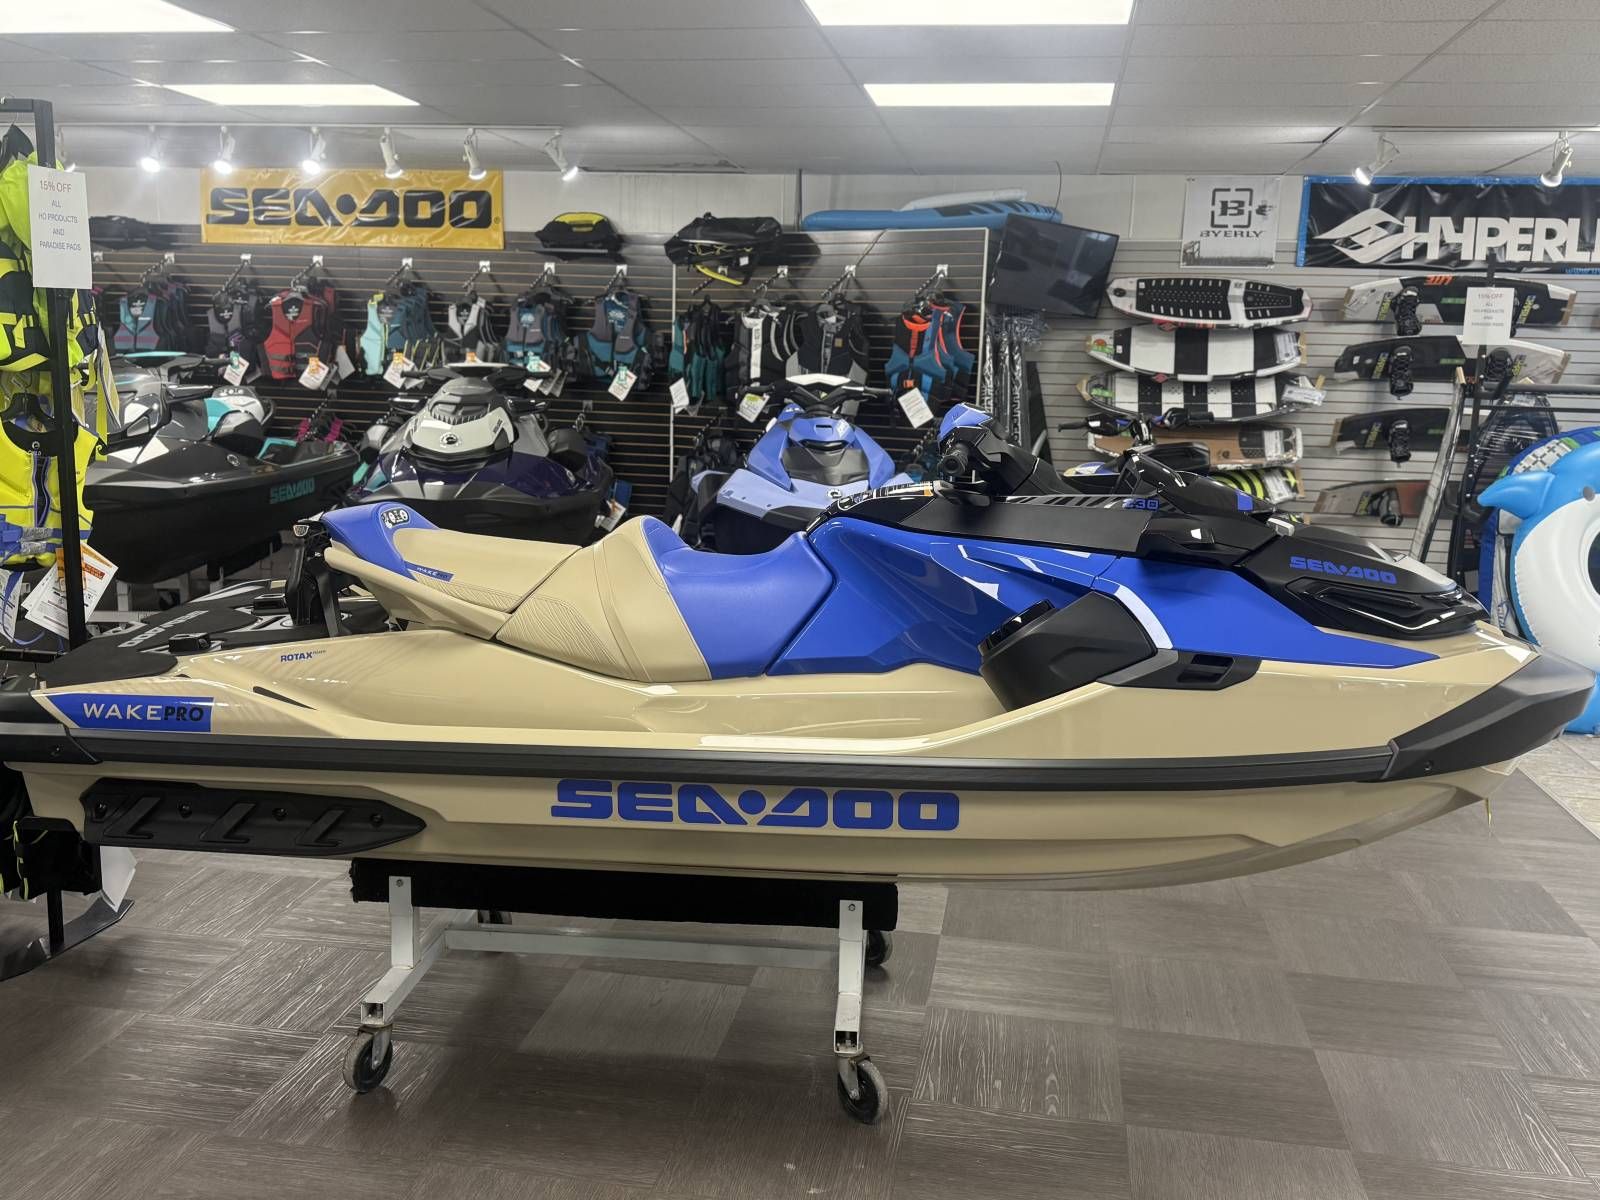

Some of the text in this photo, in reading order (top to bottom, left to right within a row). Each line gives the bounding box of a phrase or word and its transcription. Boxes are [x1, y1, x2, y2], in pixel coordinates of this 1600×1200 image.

[40, 180, 72, 193] 15% OFF
[51, 199, 62, 209] ALL
[48, 213, 79, 224] PRODUCTS
[52, 228, 65, 237] AND
[1200, 230, 1264, 238] BYERLY
[39, 240, 81, 252] PARADISE PADS
[280, 651, 313, 663] ROTAX
